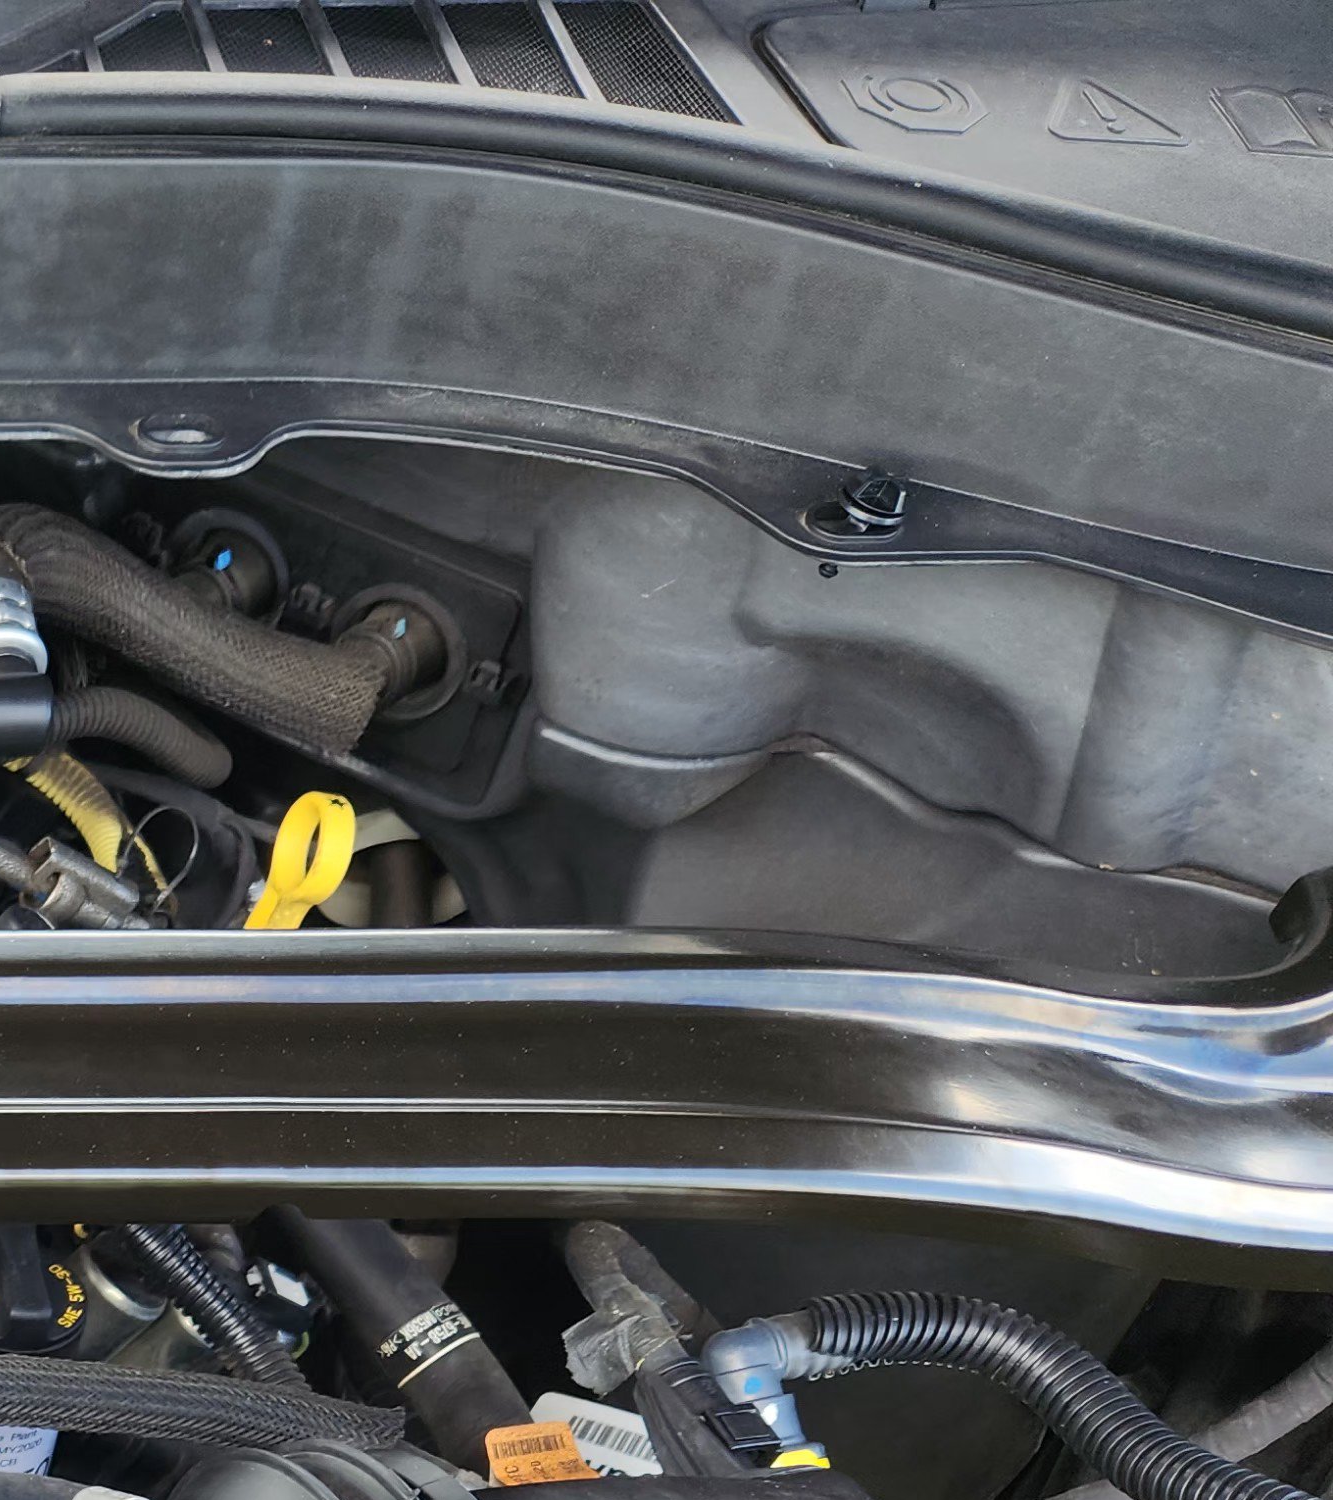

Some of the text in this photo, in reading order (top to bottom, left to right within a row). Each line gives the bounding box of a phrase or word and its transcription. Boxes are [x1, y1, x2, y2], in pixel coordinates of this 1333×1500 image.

[48, 1264, 85, 1328] SAE 5W-30
[10, 1429, 38, 1442] Plant
